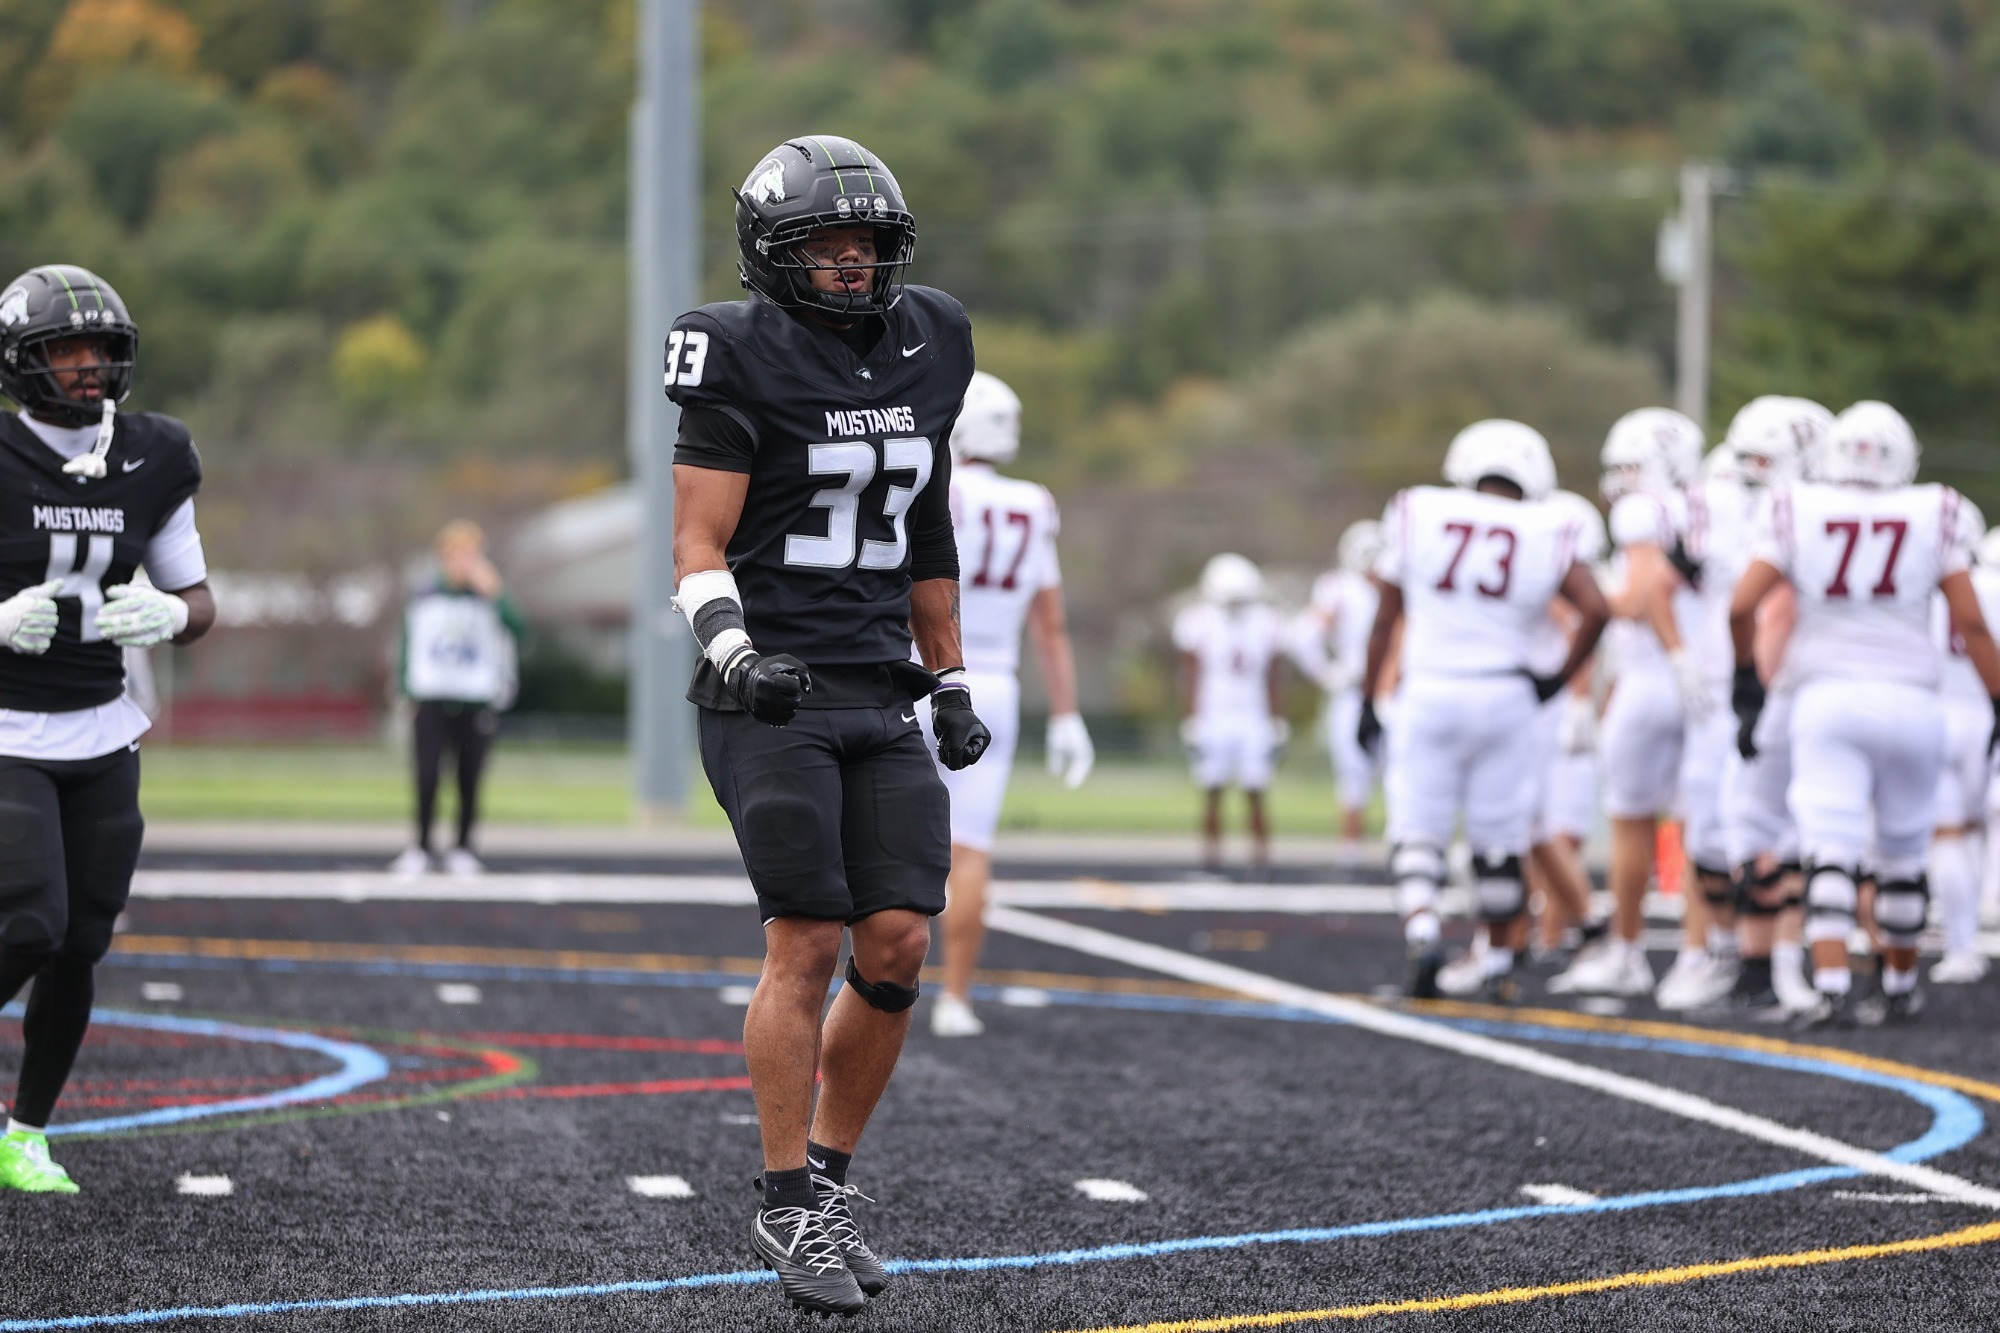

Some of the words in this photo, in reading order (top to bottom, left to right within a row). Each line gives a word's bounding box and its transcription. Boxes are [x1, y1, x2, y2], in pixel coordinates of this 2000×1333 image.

[854, 197, 868, 207] F7
[664, 330, 709, 388] 33
[825, 406, 915, 437] MUSTANGS
[33, 505, 125, 533] MUSTANGS
[784, 437, 933, 570] 33
[971, 507, 1031, 591] 17
[1435, 522, 1516, 599] 73
[1825, 519, 1908, 598] 77
[46, 533, 115, 644] 4
